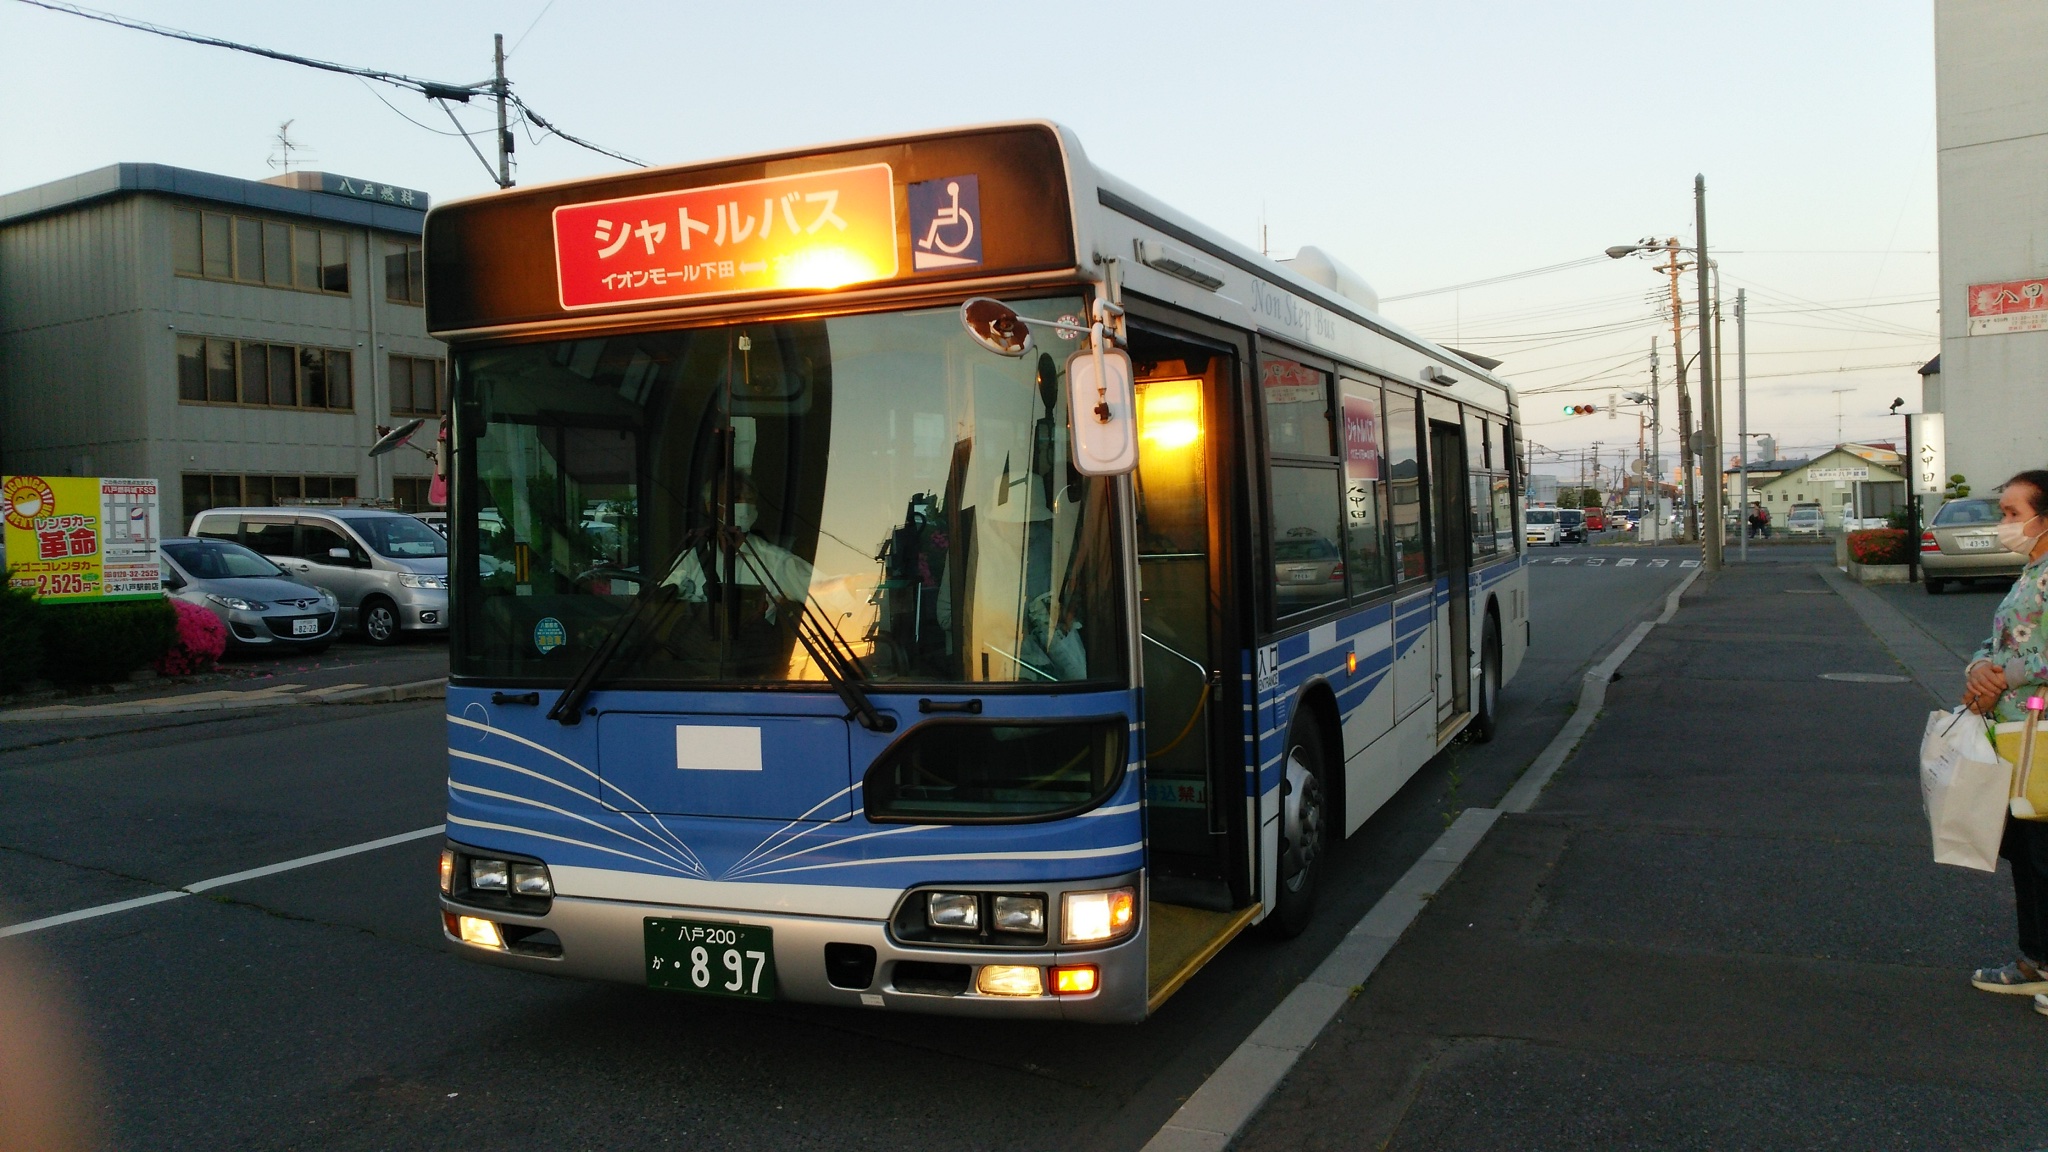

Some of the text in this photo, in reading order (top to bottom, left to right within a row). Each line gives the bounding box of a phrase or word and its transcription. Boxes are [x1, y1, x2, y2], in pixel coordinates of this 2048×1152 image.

[339, 178, 415, 206] 八戸燃料
[594, 190, 848, 259] シャトルバス
[602, 260, 735, 290] イオンモール下田
[1251, 279, 1336, 342] Non Step Bus
[1920, 444, 1937, 482] 八甲田
[36, 515, 94, 531] レンタカー
[39, 528, 96, 559] 革命
[113, 582, 159, 592] 本八戸駅前店
[1258, 645, 1277, 679] 入口
[678, 926, 736, 945] 八戸200
